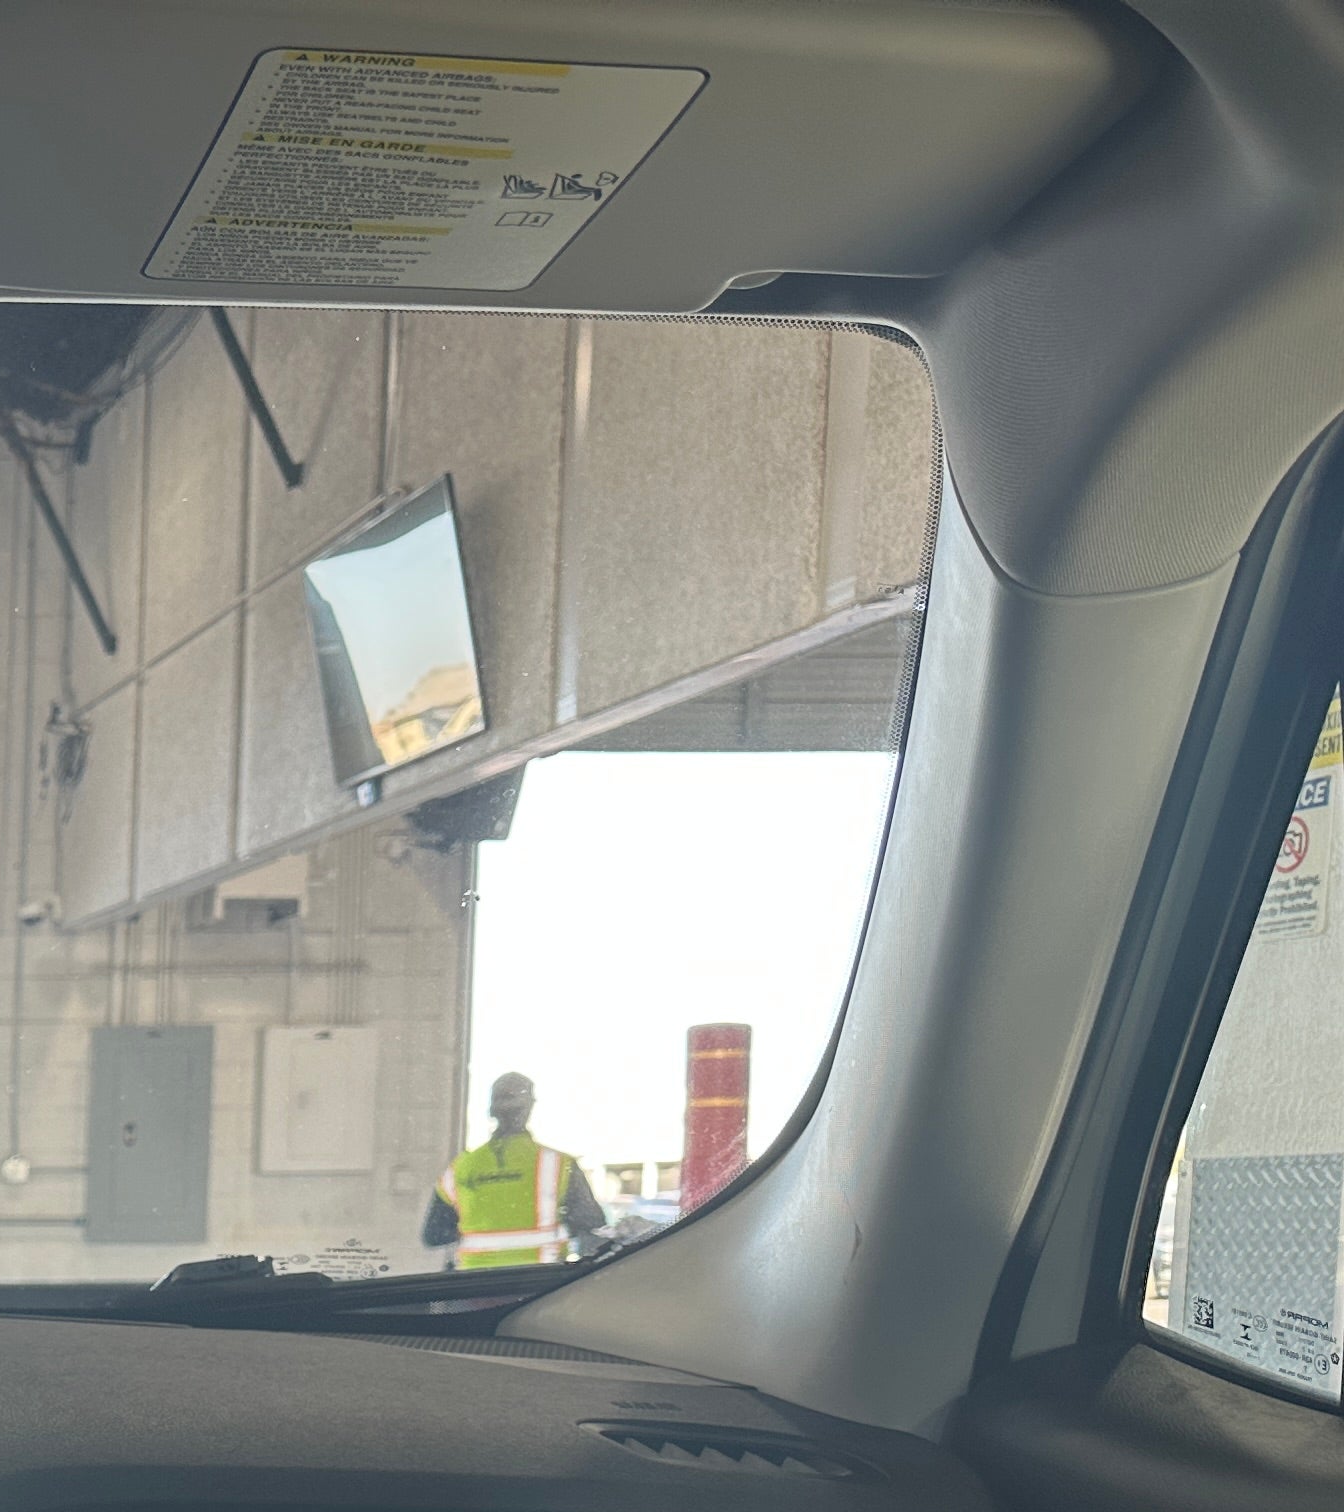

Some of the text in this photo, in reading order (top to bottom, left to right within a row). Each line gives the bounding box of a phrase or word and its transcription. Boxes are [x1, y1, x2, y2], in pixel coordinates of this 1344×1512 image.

[323, 54, 416, 68] WARNING
[280, 64, 315, 72] EVEN
[319, 66, 354, 74] WITH
[356, 68, 429, 78] ADVANCED
[278, 135, 426, 152] MISE EN GARDE
[229, 218, 354, 232] ADVERTENCIA
